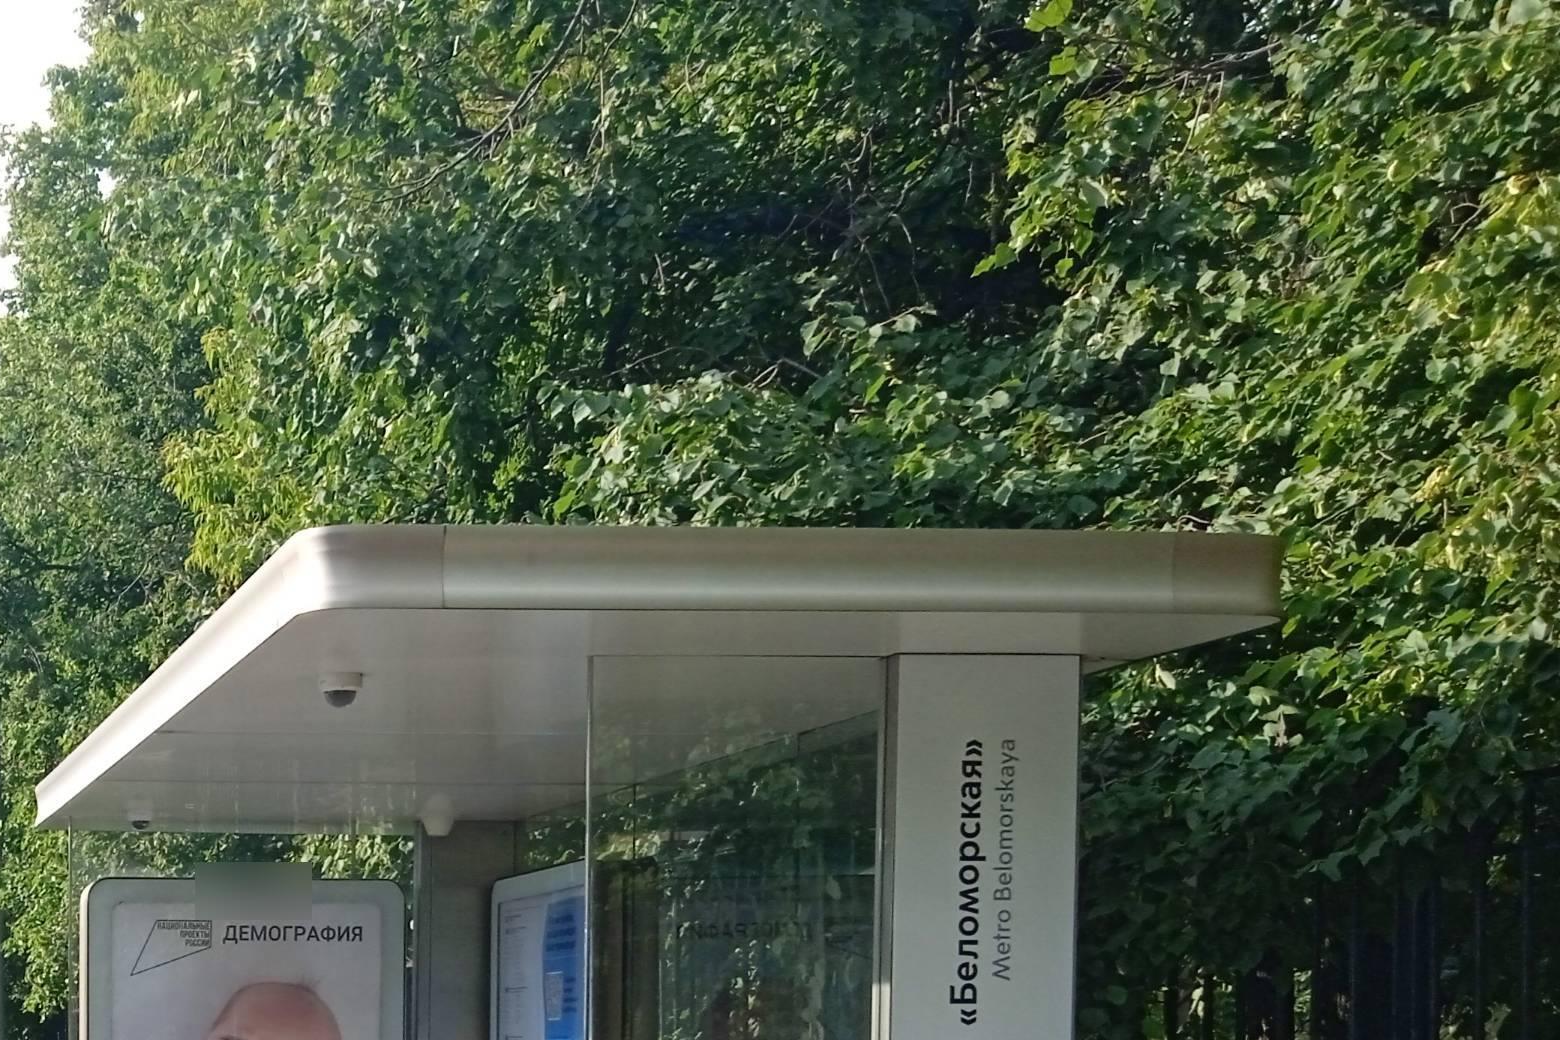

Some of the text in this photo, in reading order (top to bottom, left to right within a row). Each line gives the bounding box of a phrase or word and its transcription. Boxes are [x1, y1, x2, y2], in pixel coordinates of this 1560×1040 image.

[222, 924, 363, 945] ДЕМОГРАФИЯ
[949, 738, 987, 1027] «Беломорская»
[991, 738, 1022, 981] Metro Belomorskaya
